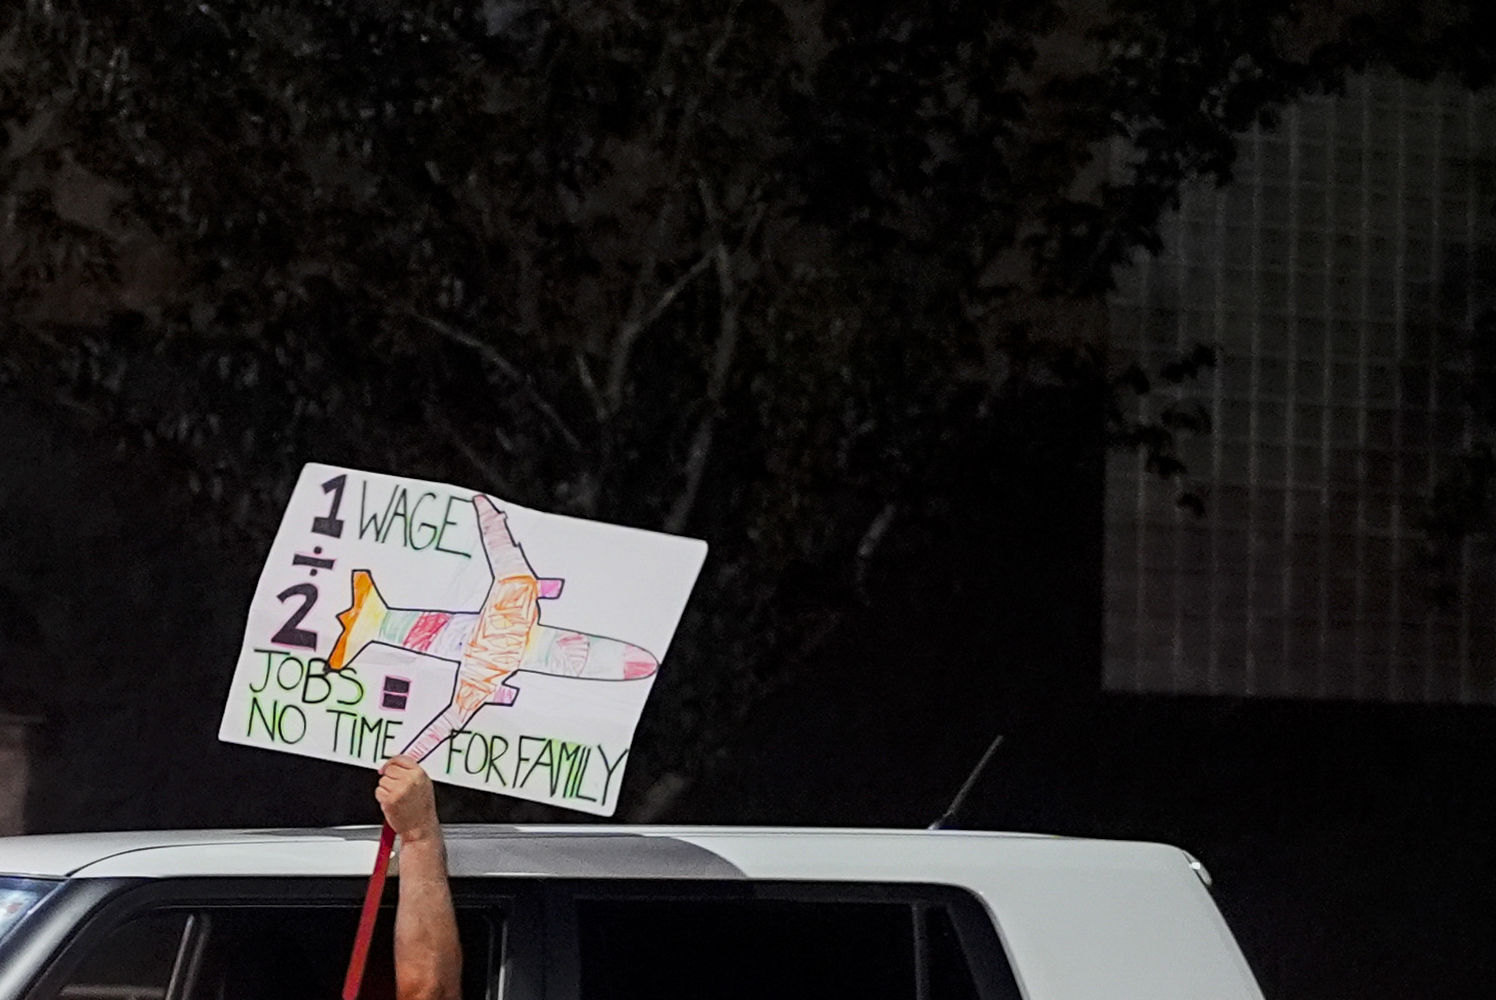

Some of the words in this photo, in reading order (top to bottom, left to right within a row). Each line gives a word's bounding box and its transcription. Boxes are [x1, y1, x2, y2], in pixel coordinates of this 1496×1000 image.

[310, 473, 348, 539] 1
[358, 480, 473, 559] WAGE
[270, 582, 320, 652] 2
[248, 648, 365, 706] JOBS
[246, 696, 308, 745] NO
[326, 708, 404, 764] TIME
[446, 728, 507, 788] FOR
[512, 736, 630, 807] FAMILY
